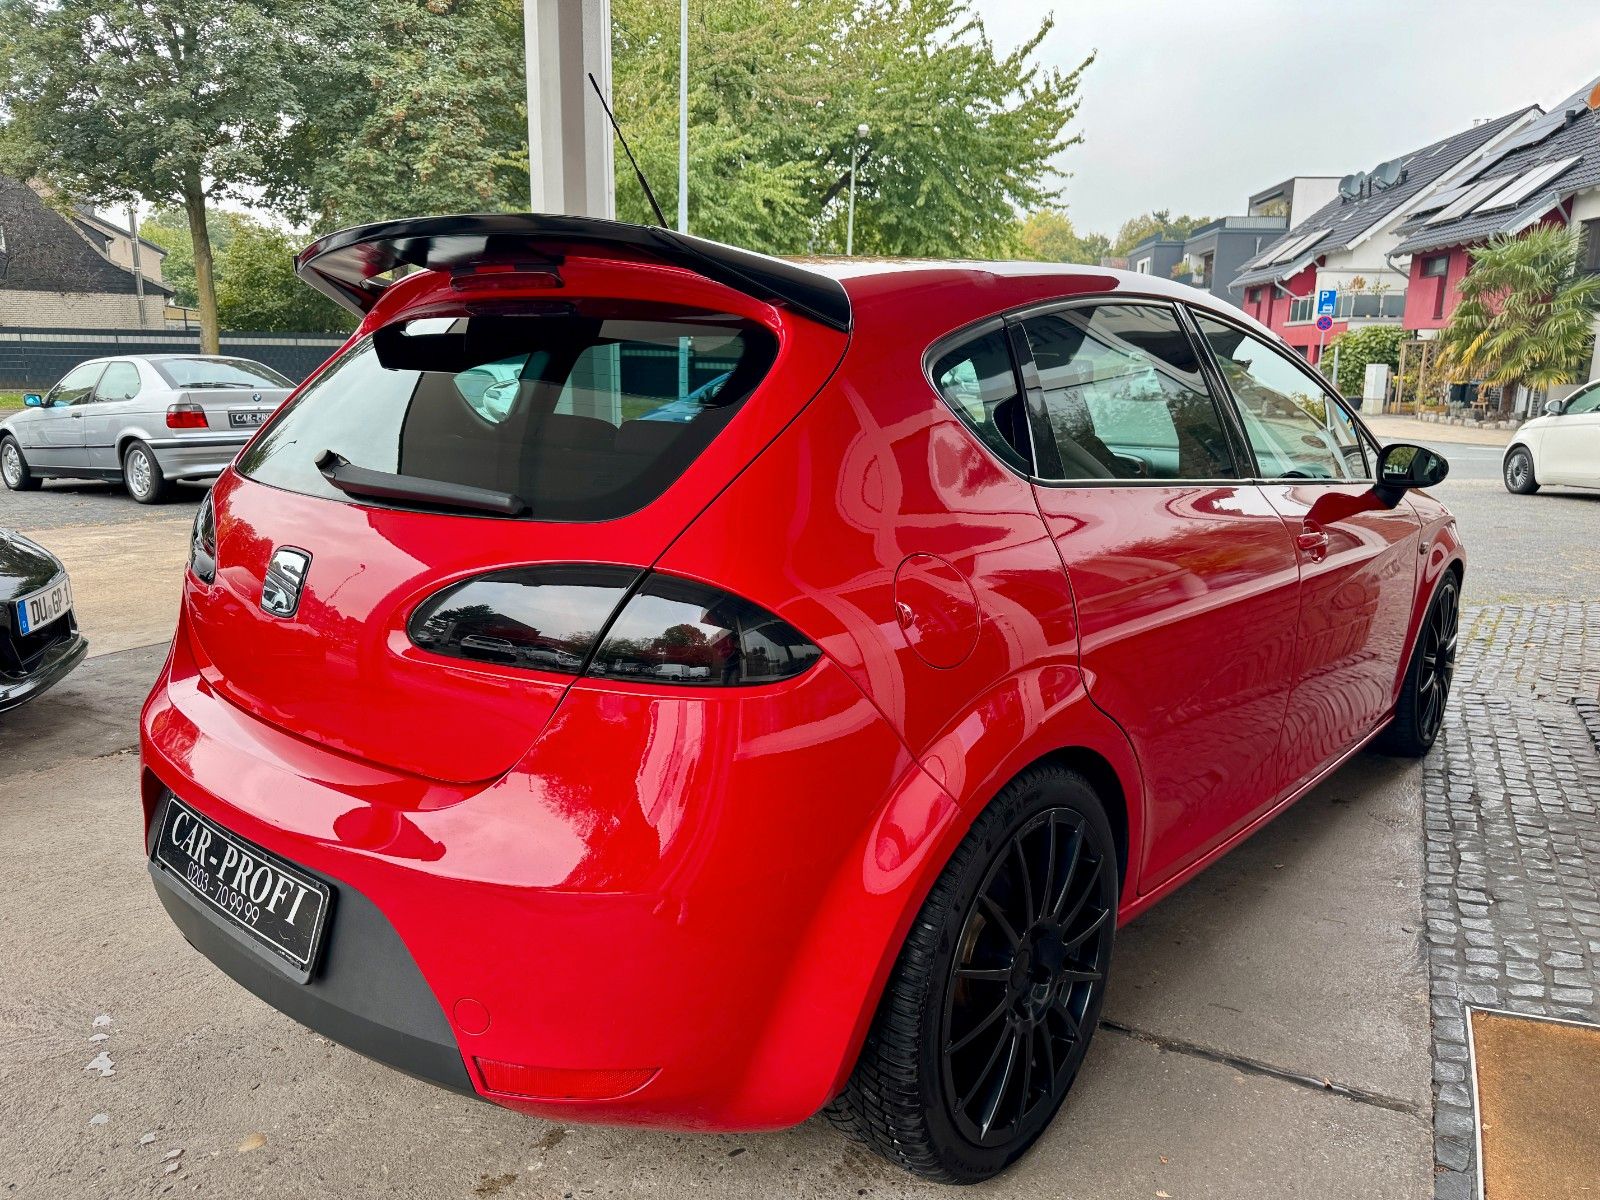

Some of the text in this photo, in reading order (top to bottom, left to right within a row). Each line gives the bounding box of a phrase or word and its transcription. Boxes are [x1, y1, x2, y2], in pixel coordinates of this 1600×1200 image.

[1321, 291, 1329, 302] P
[30, 596, 48, 626] DU
[51, 587, 63, 615] GP
[171, 811, 309, 926] CAR-PROFI
[187, 860, 210, 892] 0203
